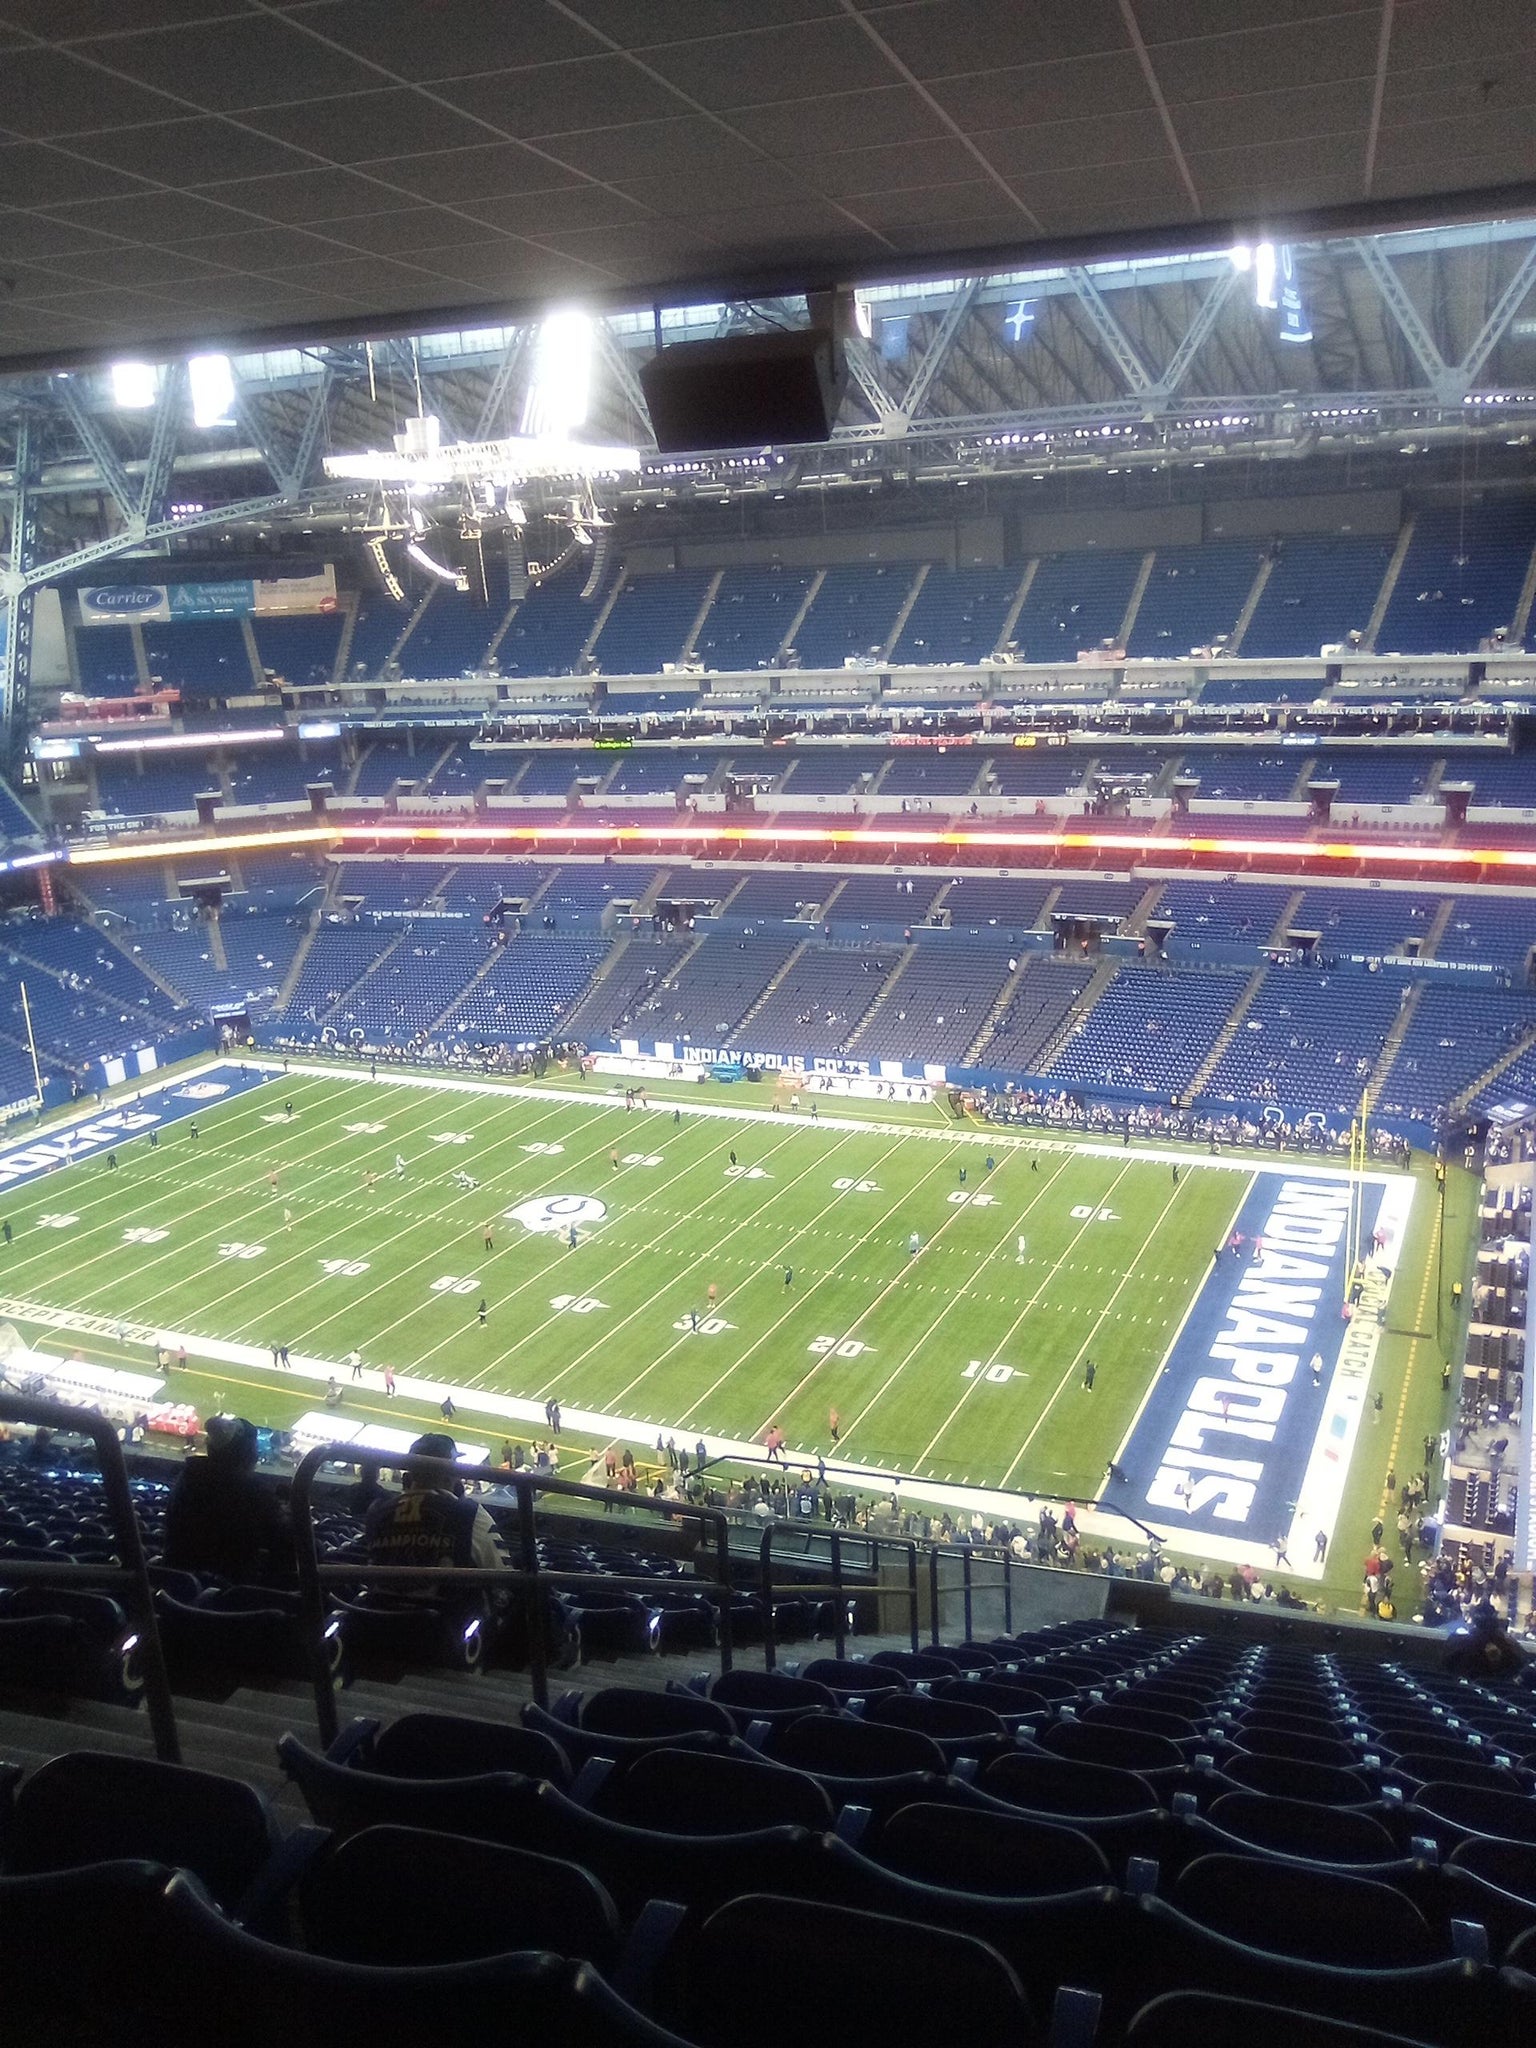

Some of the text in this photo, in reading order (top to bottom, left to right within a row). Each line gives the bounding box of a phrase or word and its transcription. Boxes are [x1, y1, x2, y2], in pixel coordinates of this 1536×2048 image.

[96, 591, 153, 605] Carrier
[198, 585, 247, 595] Ascension
[683, 1047, 870, 1075] INDIANAPOLIS COLTS
[989, 1137, 1077, 1150] CANCER
[429, 1275, 482, 1294] 50
[548, 1294, 602, 1313] 40
[671, 1313, 728, 1335] 30
[806, 1335, 866, 1358] 20
[1146, 1181, 1357, 1522] INDIANAPOLIS
[1341, 1331, 1373, 1378] CATCH
[961, 1360, 1016, 1383] 10
